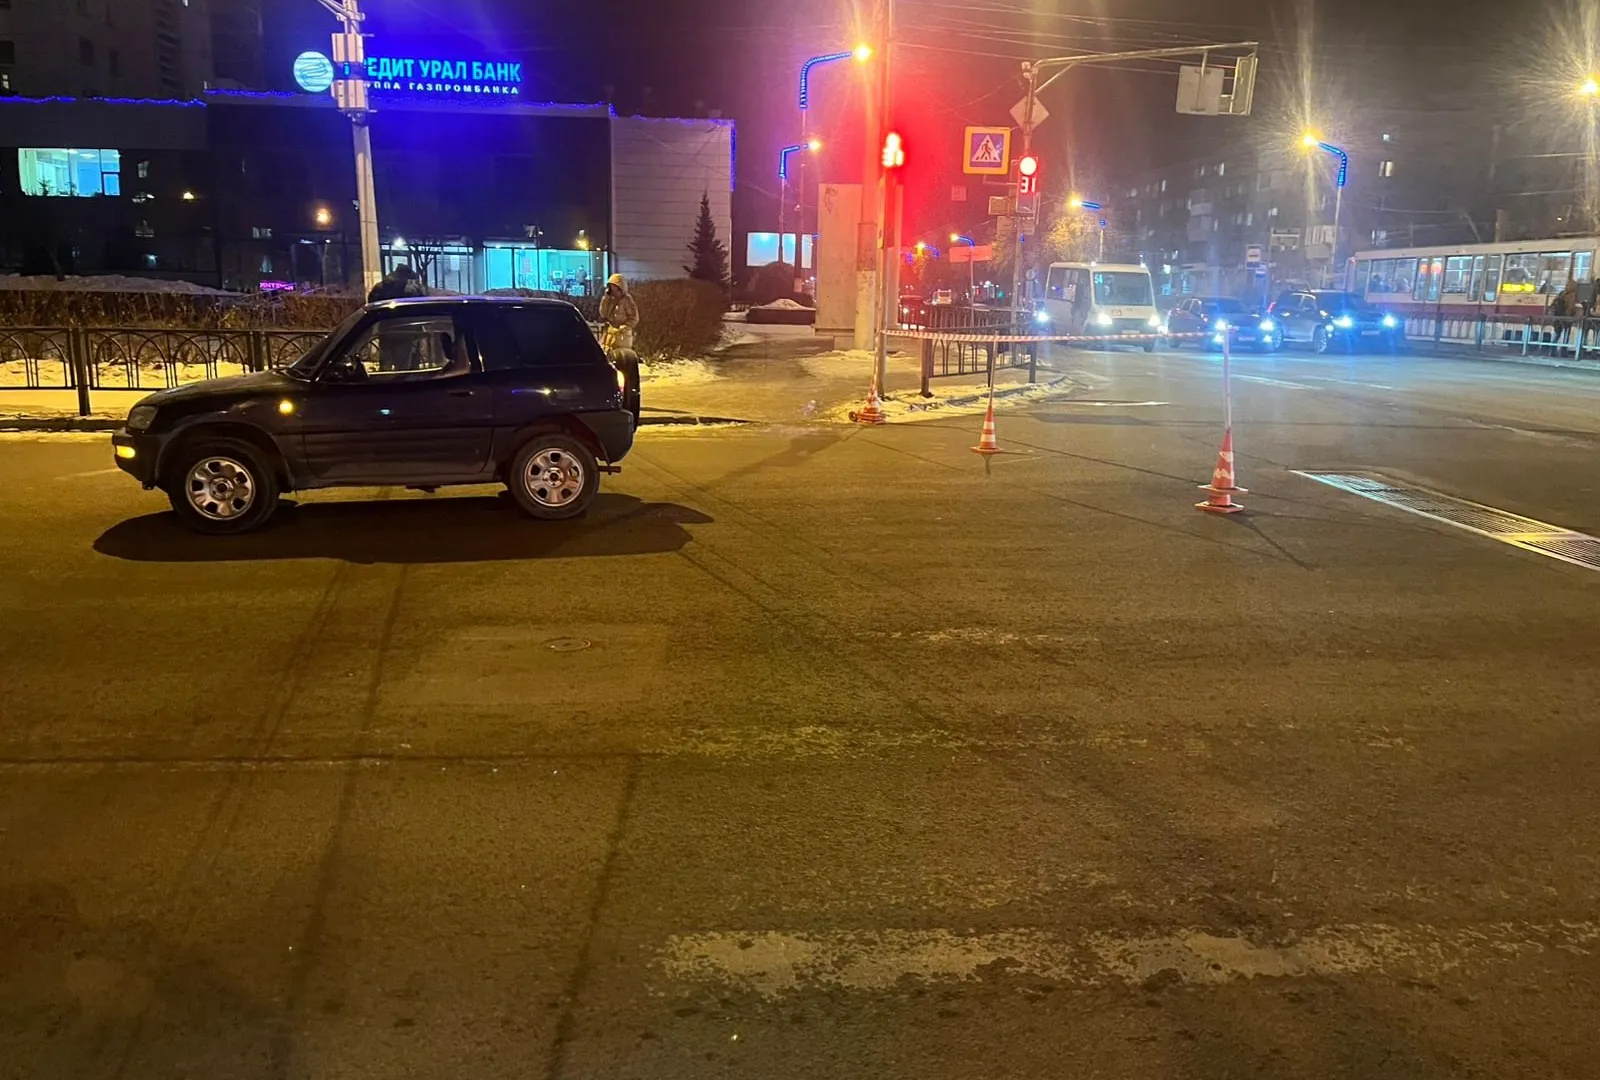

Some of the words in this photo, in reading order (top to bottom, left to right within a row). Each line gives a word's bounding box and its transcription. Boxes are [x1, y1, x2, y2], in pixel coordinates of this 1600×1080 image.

[343, 57, 415, 80] ЕДИТ
[418, 59, 467, 80] УРАЛ
[472, 62, 521, 82] БАНК
[409, 82, 519, 94] ГАЗПРОМБАНКА
[1020, 176, 1036, 193] 31
